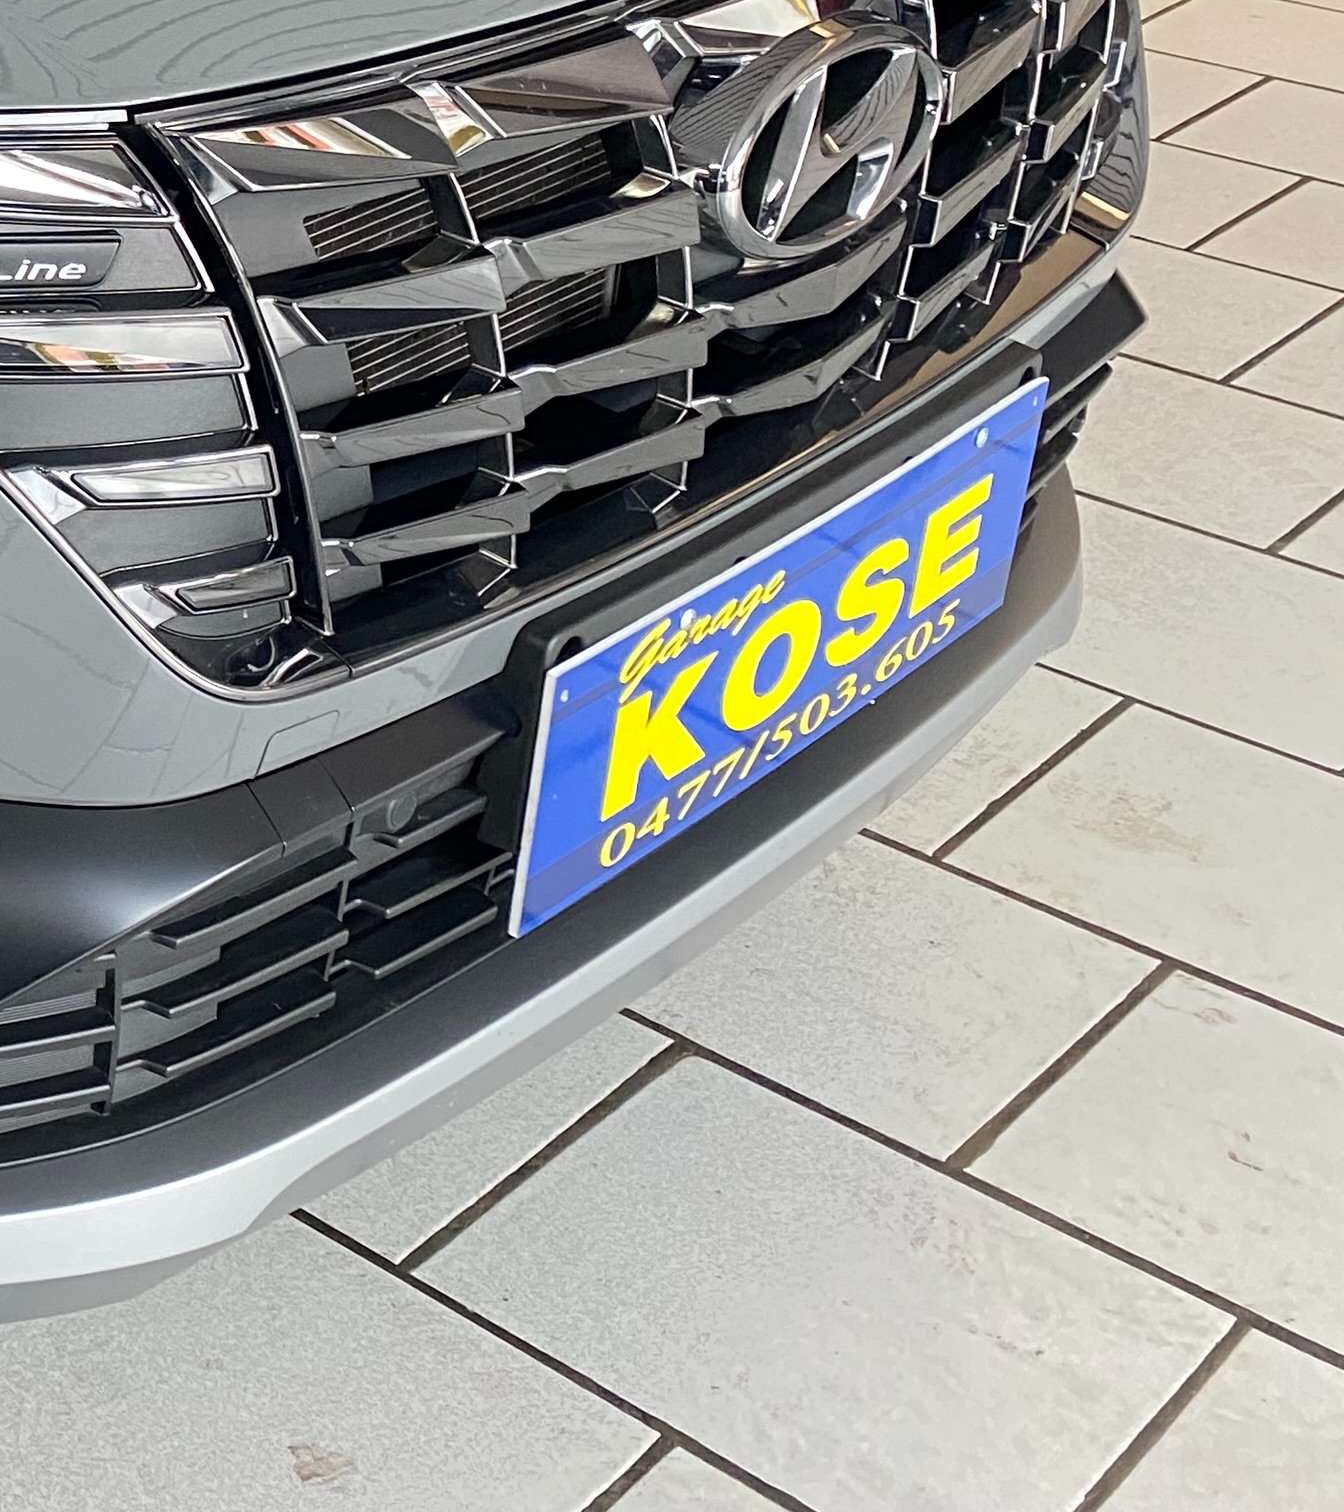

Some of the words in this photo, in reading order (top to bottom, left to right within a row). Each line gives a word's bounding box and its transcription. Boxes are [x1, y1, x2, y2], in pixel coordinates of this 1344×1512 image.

[599, 599, 960, 868] 0477/503.605
[600, 473, 994, 822] KOSE
[618, 570, 787, 703] Garage
